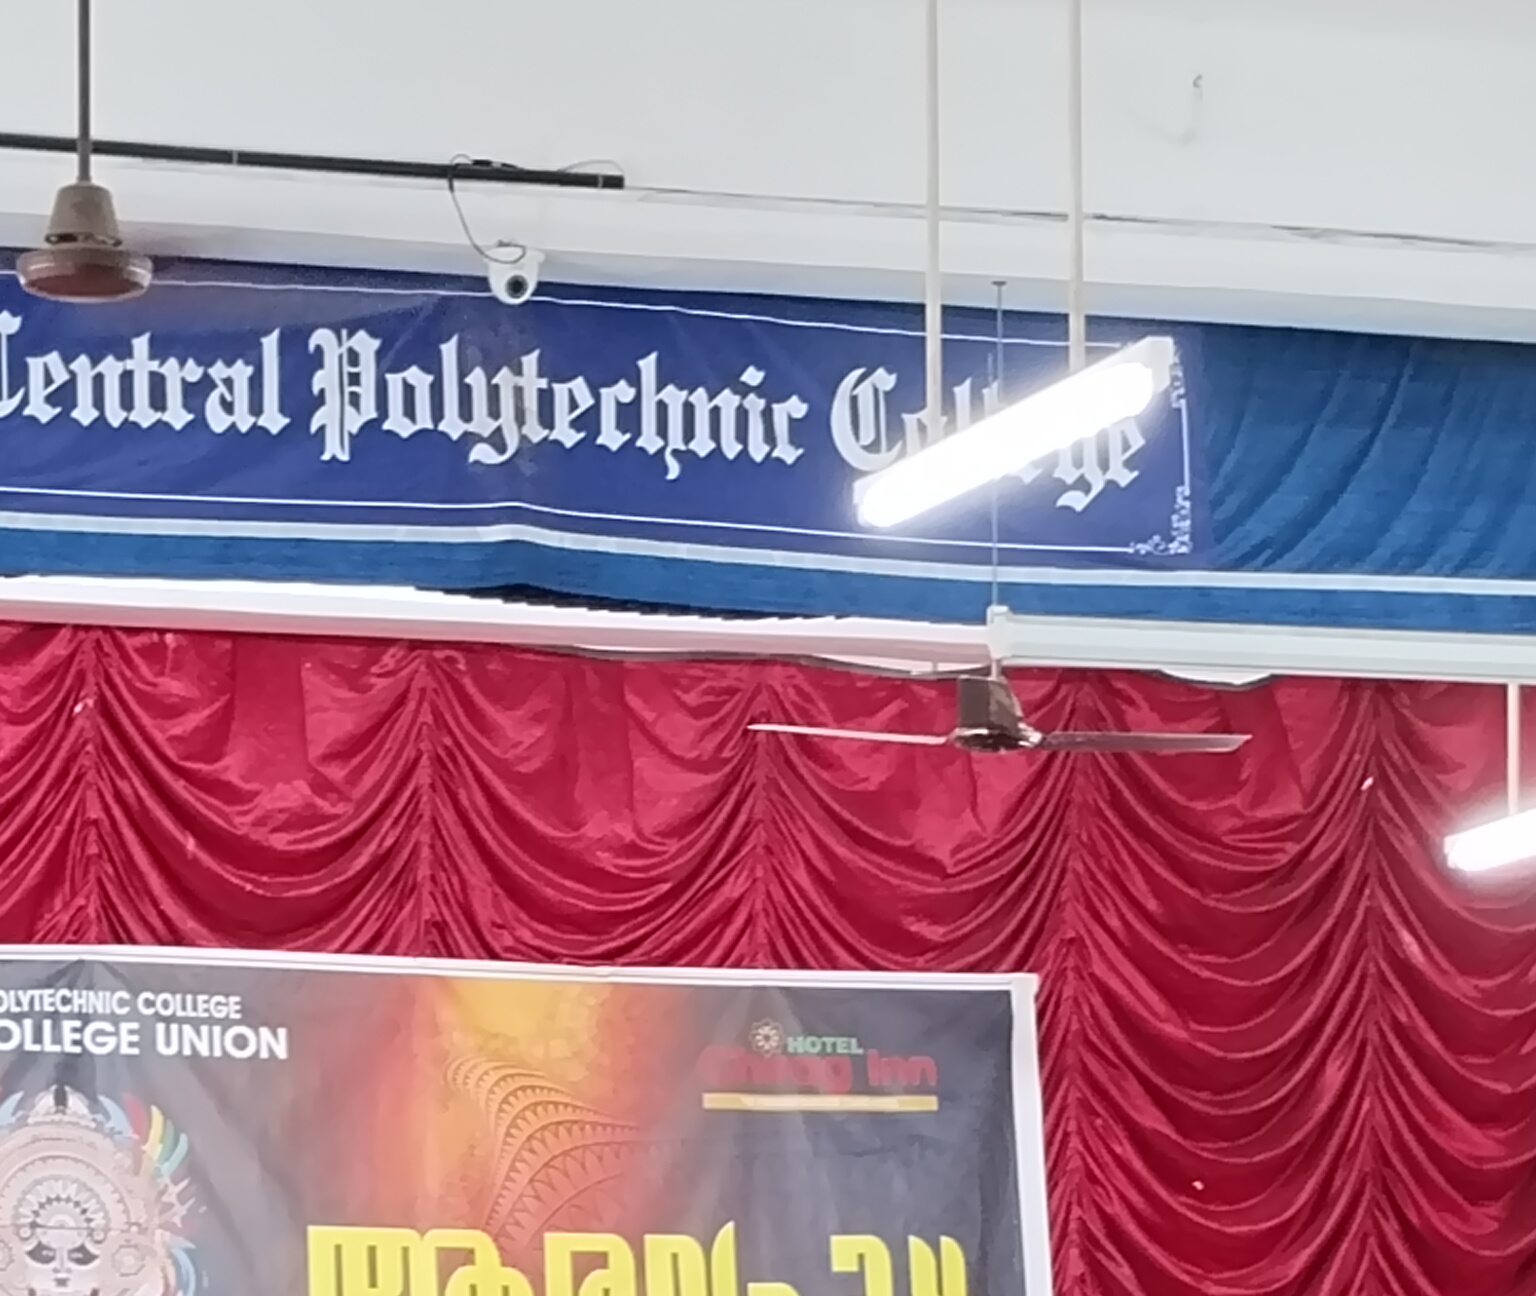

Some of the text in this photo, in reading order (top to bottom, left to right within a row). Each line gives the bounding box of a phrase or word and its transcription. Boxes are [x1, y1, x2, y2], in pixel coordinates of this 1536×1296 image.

[309, 325, 810, 481] Polytechnic
[137, 991, 242, 1022] COLLEGE
[155, 1023, 289, 1060] UNION
[786, 1036, 864, 1054] HOTEL
